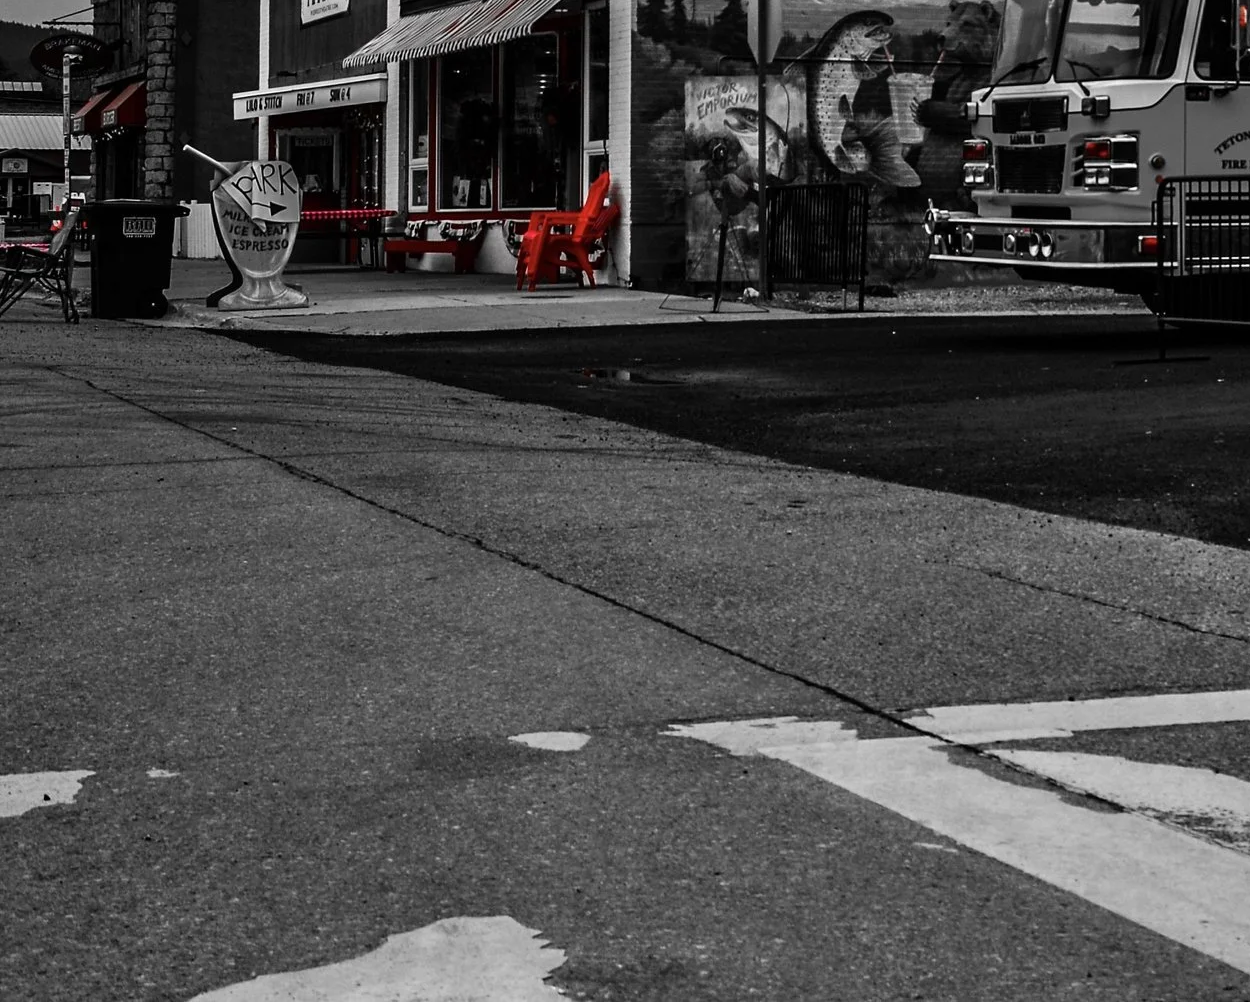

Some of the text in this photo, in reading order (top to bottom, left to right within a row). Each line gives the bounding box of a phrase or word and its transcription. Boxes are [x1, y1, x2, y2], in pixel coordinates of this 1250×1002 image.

[697, 82, 738, 101] VICTOR
[245, 98, 258, 113] LILO
[263, 95, 283, 110] STITCH
[697, 92, 758, 121] EMPORIUM
[1221, 159, 1247, 170] FIRE
[229, 224, 249, 237] ICE
[231, 238, 290, 252] ESPRESSO
